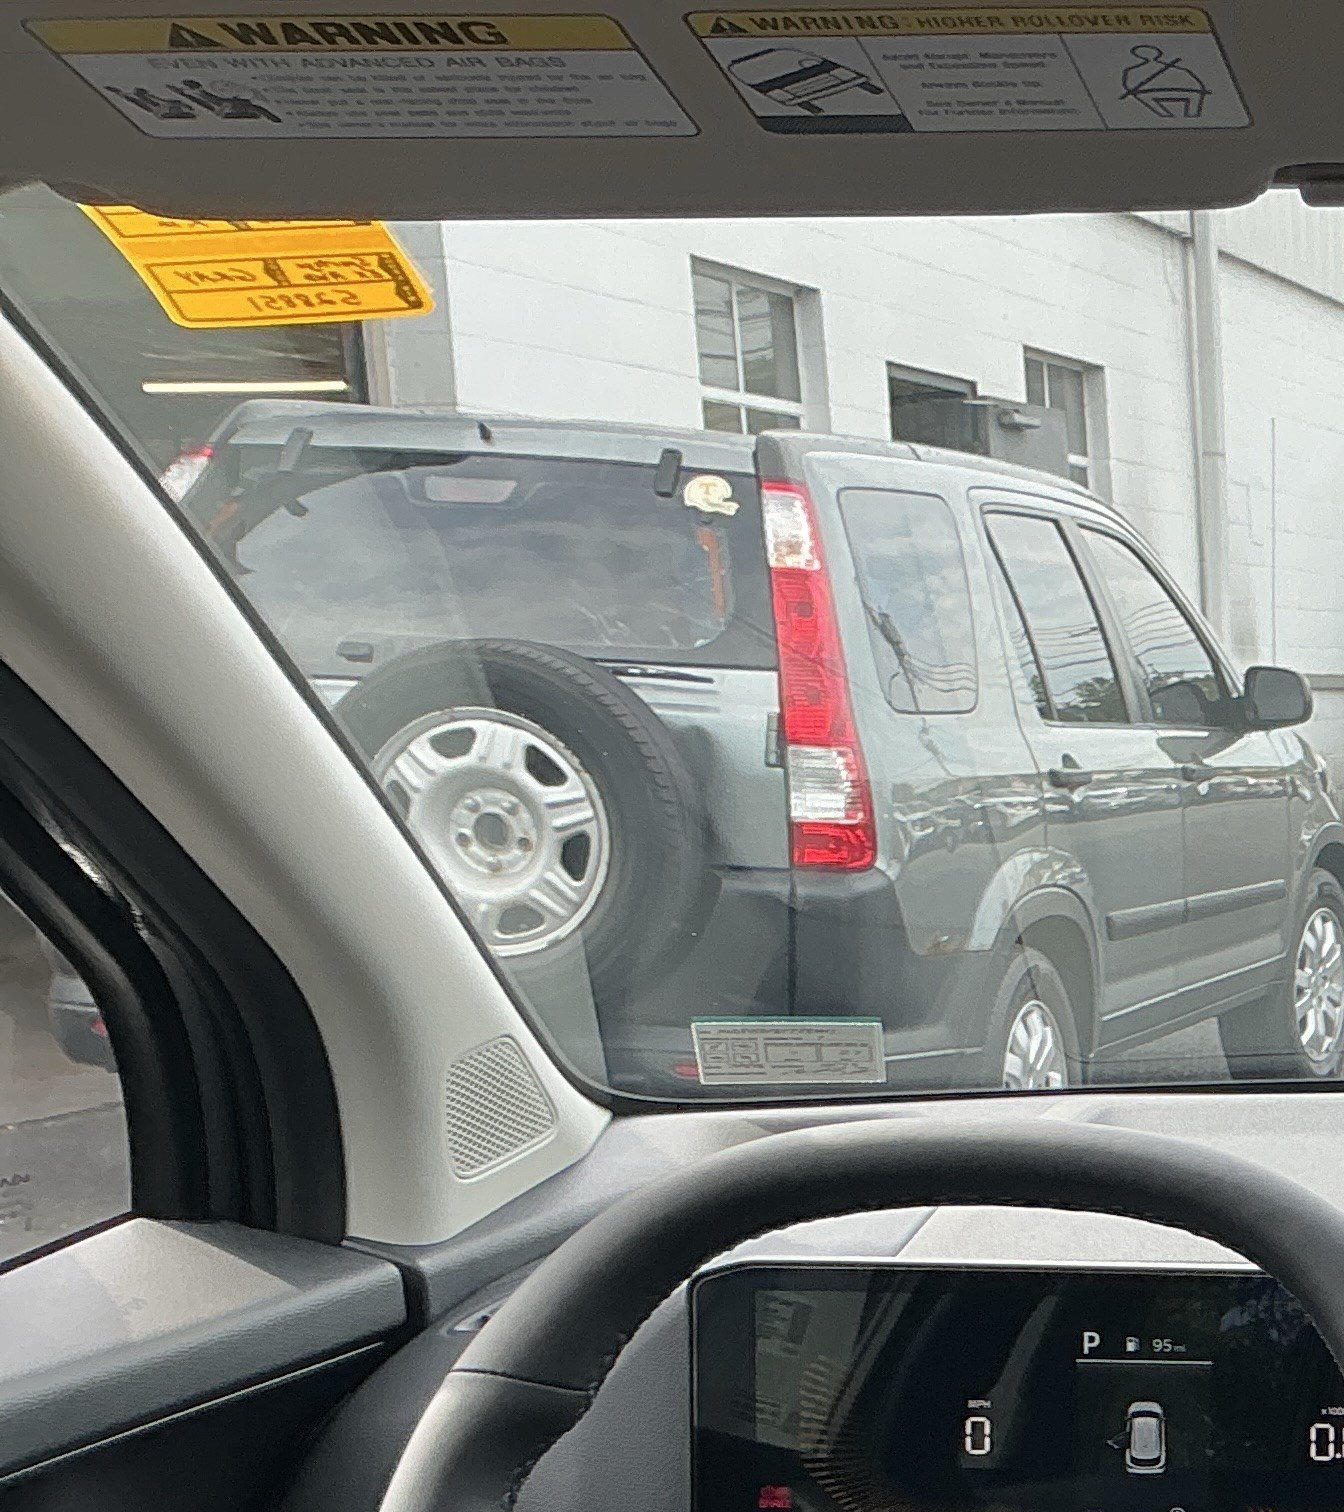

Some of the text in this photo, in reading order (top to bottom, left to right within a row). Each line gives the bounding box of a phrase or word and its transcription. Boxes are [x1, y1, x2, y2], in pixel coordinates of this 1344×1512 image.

[915, 16, 1003, 29] HIGHER
[1010, 13, 1131, 28] ROLLOVER
[1138, 13, 1195, 27] RISK
[217, 19, 511, 47] WARNING
[148, 56, 566, 70] EVEN WITH ADVANCED AIR BAGS
[1083, 1331, 1100, 1354] P
